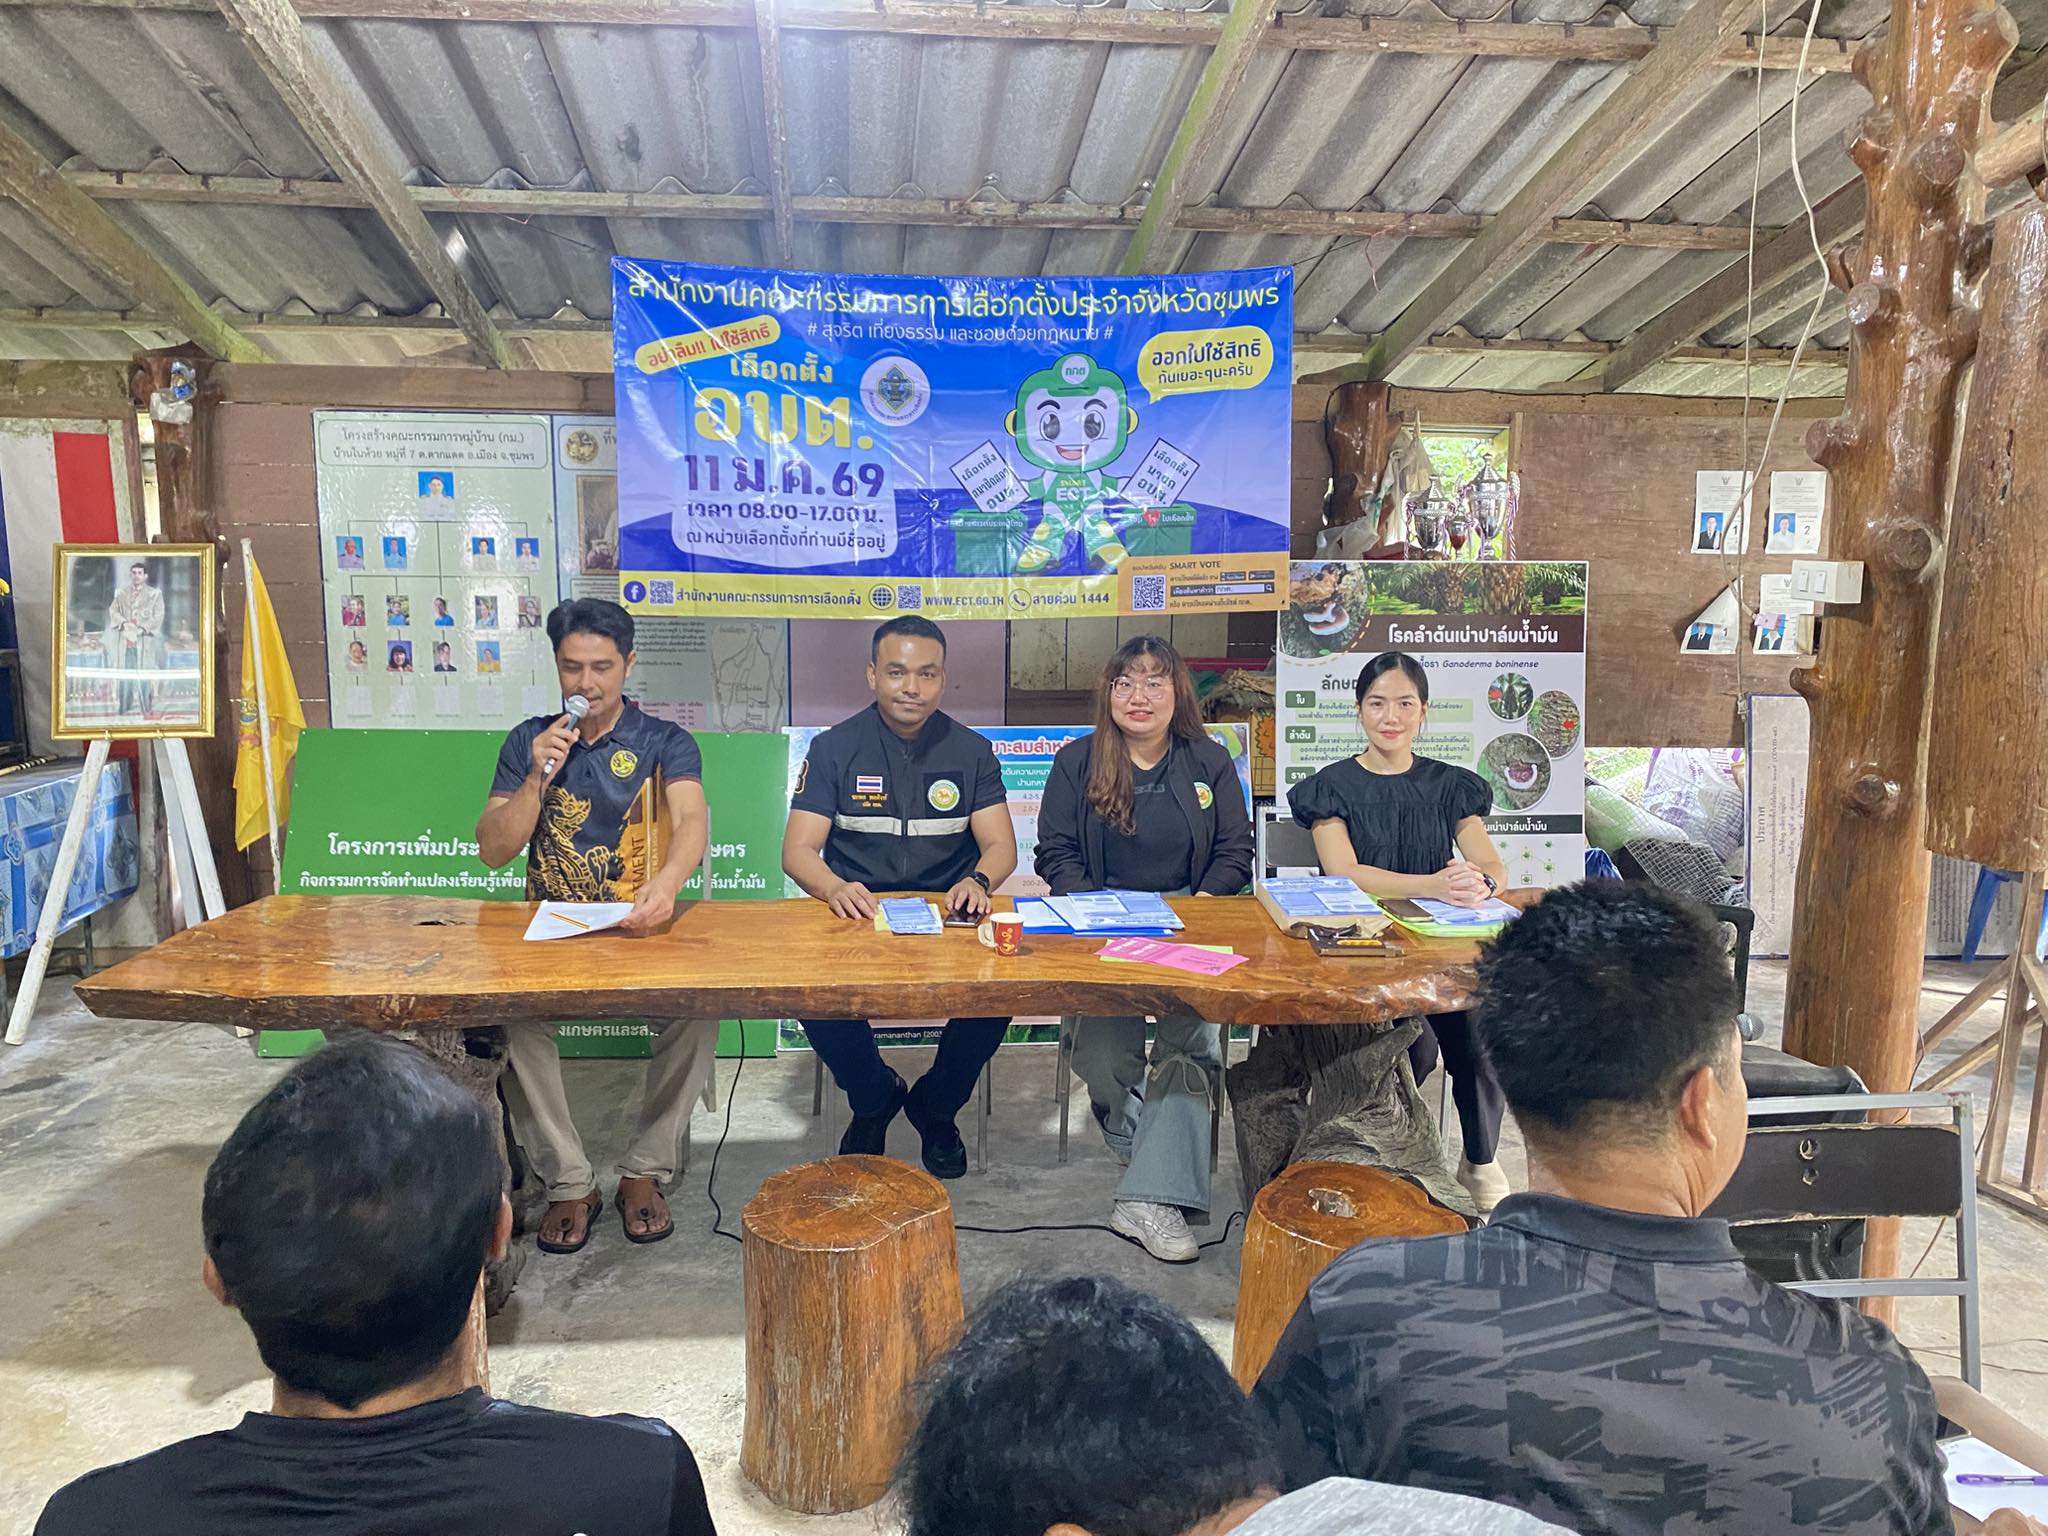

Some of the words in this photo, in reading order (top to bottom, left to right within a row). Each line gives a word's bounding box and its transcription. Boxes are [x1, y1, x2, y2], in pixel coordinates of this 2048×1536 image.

[822, 321, 863, 342] สุจริต
[868, 318, 945, 340] เที่ยงธรรม
[949, 324, 1099, 344] และชอบด้วยกฎหมาย
[1152, 338, 1262, 367] ออกไปใช้สิทธิ
[730, 352, 834, 384] เลือกตั้ง
[694, 387, 874, 449] อบต.
[341, 427, 495, 446] โครงสร้างคณะกรรมการหมู่บ้าน
[961, 453, 998, 481] เลือกตั้ง
[1153, 449, 1189, 477] เลือกตั้ง
[684, 454, 721, 492] 11
[831, 461, 886, 498] 69
[1147, 465, 1177, 490] นายก
[1056, 487, 1089, 502] ECT
[687, 502, 733, 519] เวลา
[704, 525, 887, 553] หน่วยเลือกตั้งที่ท่านมีชื่ออยู่
[1804, 525, 1811, 535] 2
[1169, 561, 1197, 570] SMART
[1199, 560, 1221, 569] VOTE
[676, 587, 862, 607] สำนักงานคณะกรรมการการเลือกตั้ง
[1033, 591, 1077, 606] สายด่วน
[1080, 592, 1110, 604] 1444
[1388, 618, 1560, 644] โรคลำต้นเน่าปาล์มน้ำมัน
[1442, 660, 1493, 668] Ganoderma
[1495, 660, 1540, 668] boninense
[1295, 693, 1306, 705] ใบ
[1289, 728, 1312, 740] ลำต้น
[1290, 771, 1307, 779] ราก
